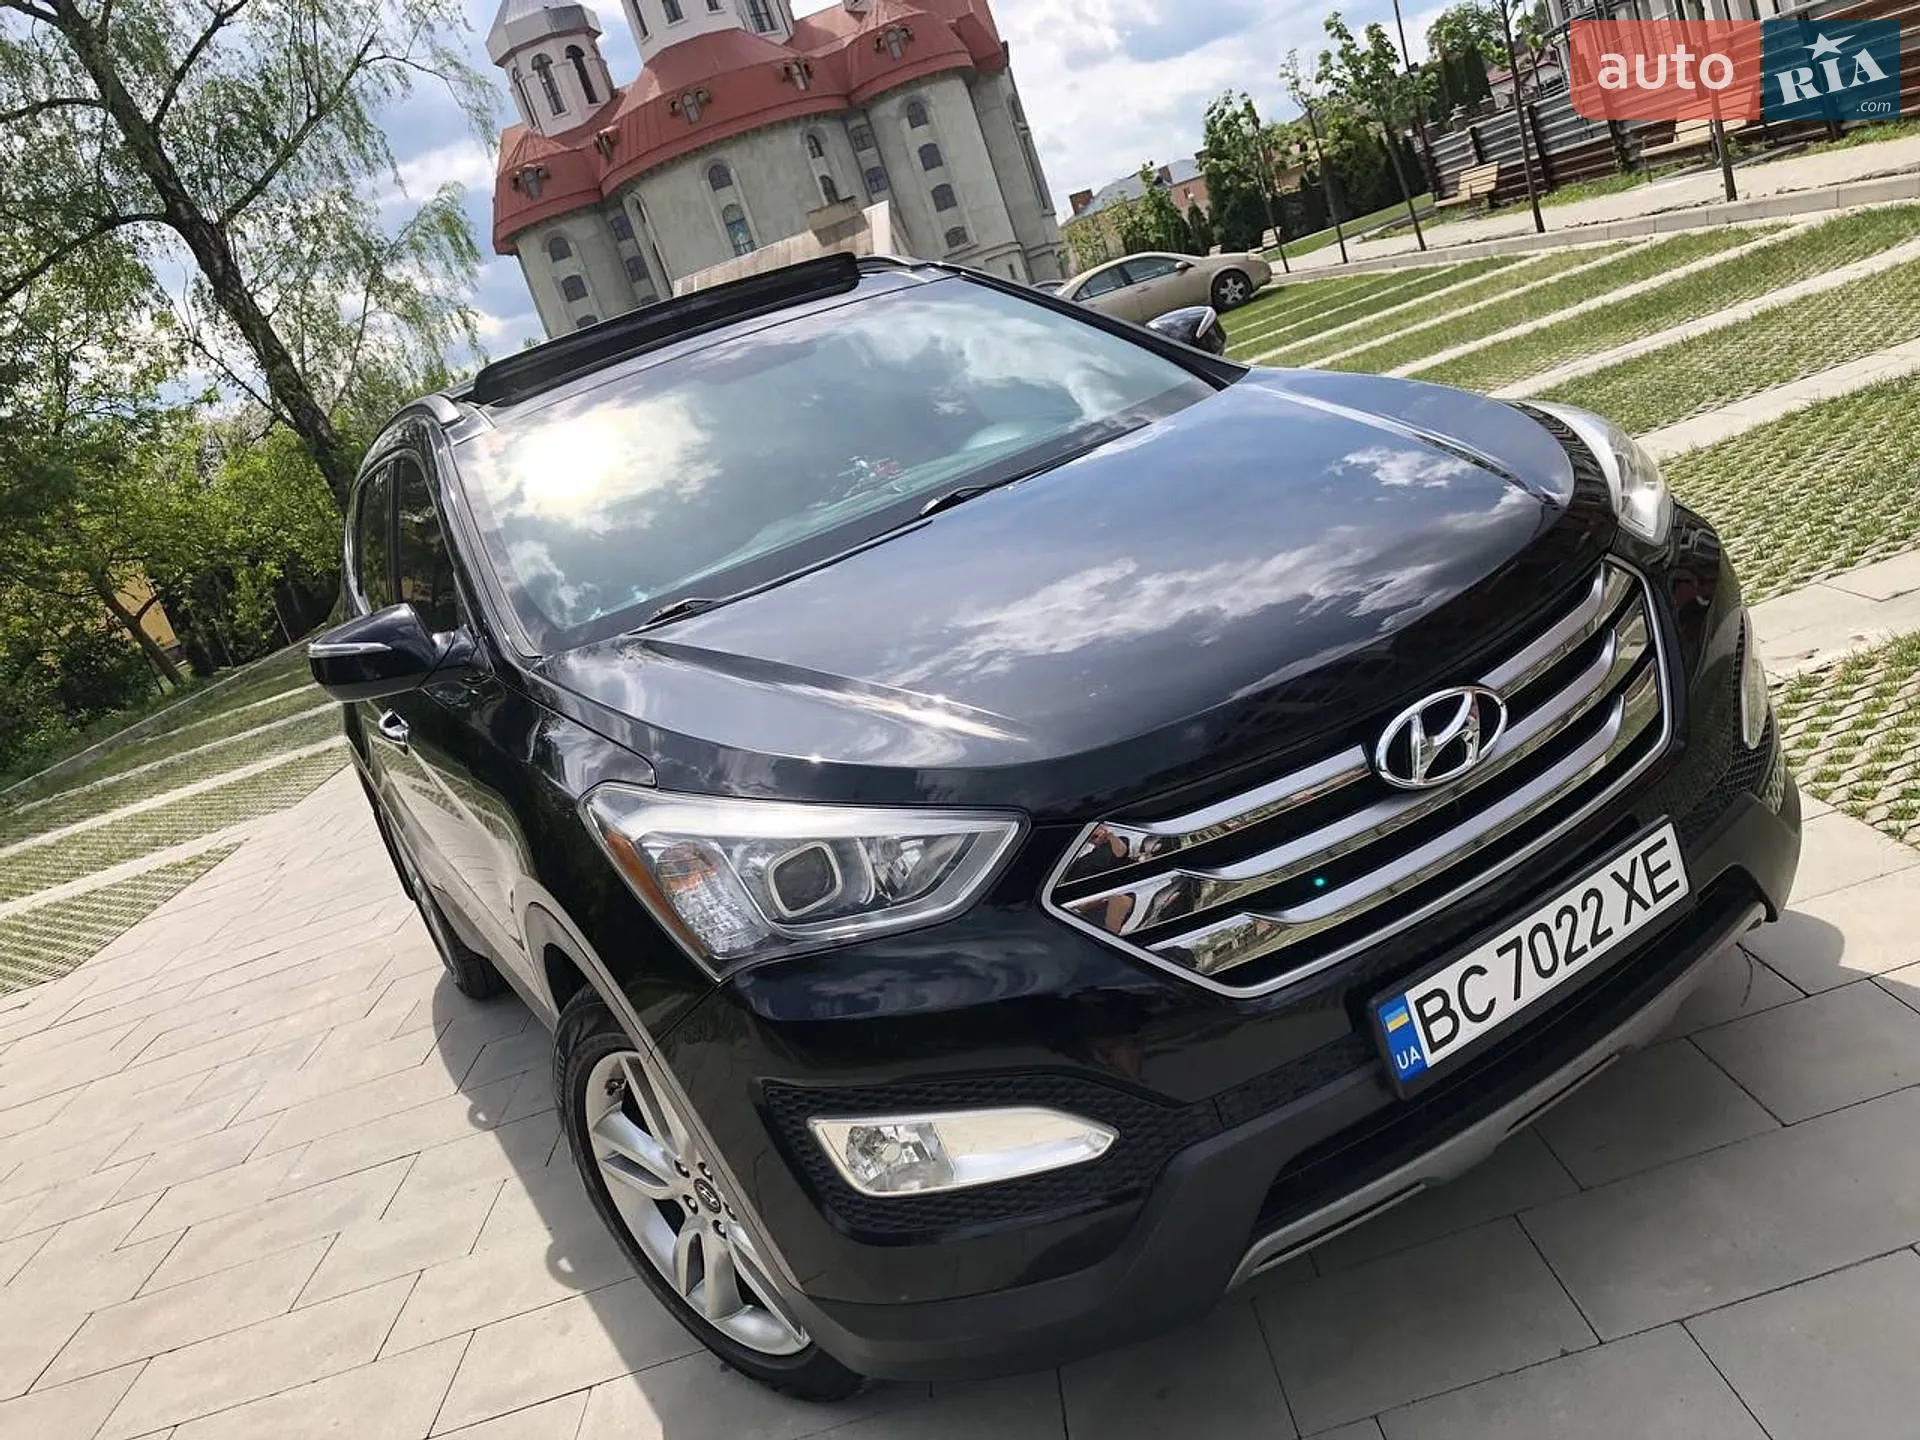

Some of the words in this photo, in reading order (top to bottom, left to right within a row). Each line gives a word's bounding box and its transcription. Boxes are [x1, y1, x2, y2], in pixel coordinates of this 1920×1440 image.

[1414, 964, 1496, 1054] BC
[1496, 888, 1613, 1000] 7022
[1610, 837, 1680, 926] XE
[1396, 1045, 1422, 1070] UA
